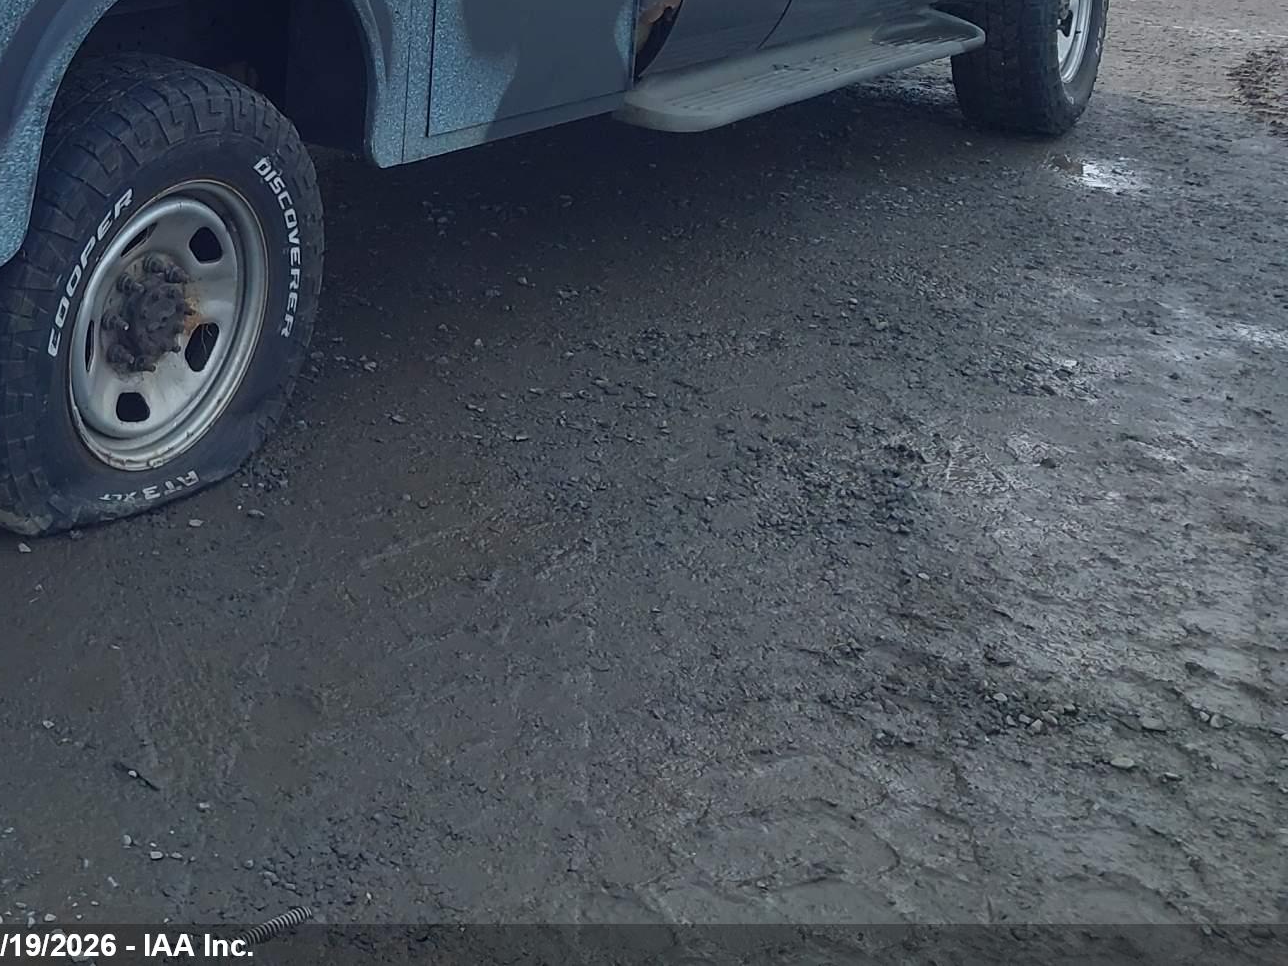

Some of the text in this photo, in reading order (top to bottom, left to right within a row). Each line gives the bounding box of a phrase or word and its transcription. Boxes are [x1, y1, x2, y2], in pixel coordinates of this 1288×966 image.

[47, 187, 134, 358] COOPER
[253, 156, 303, 339] DISCOVERER
[142, 470, 200, 500] AT3
